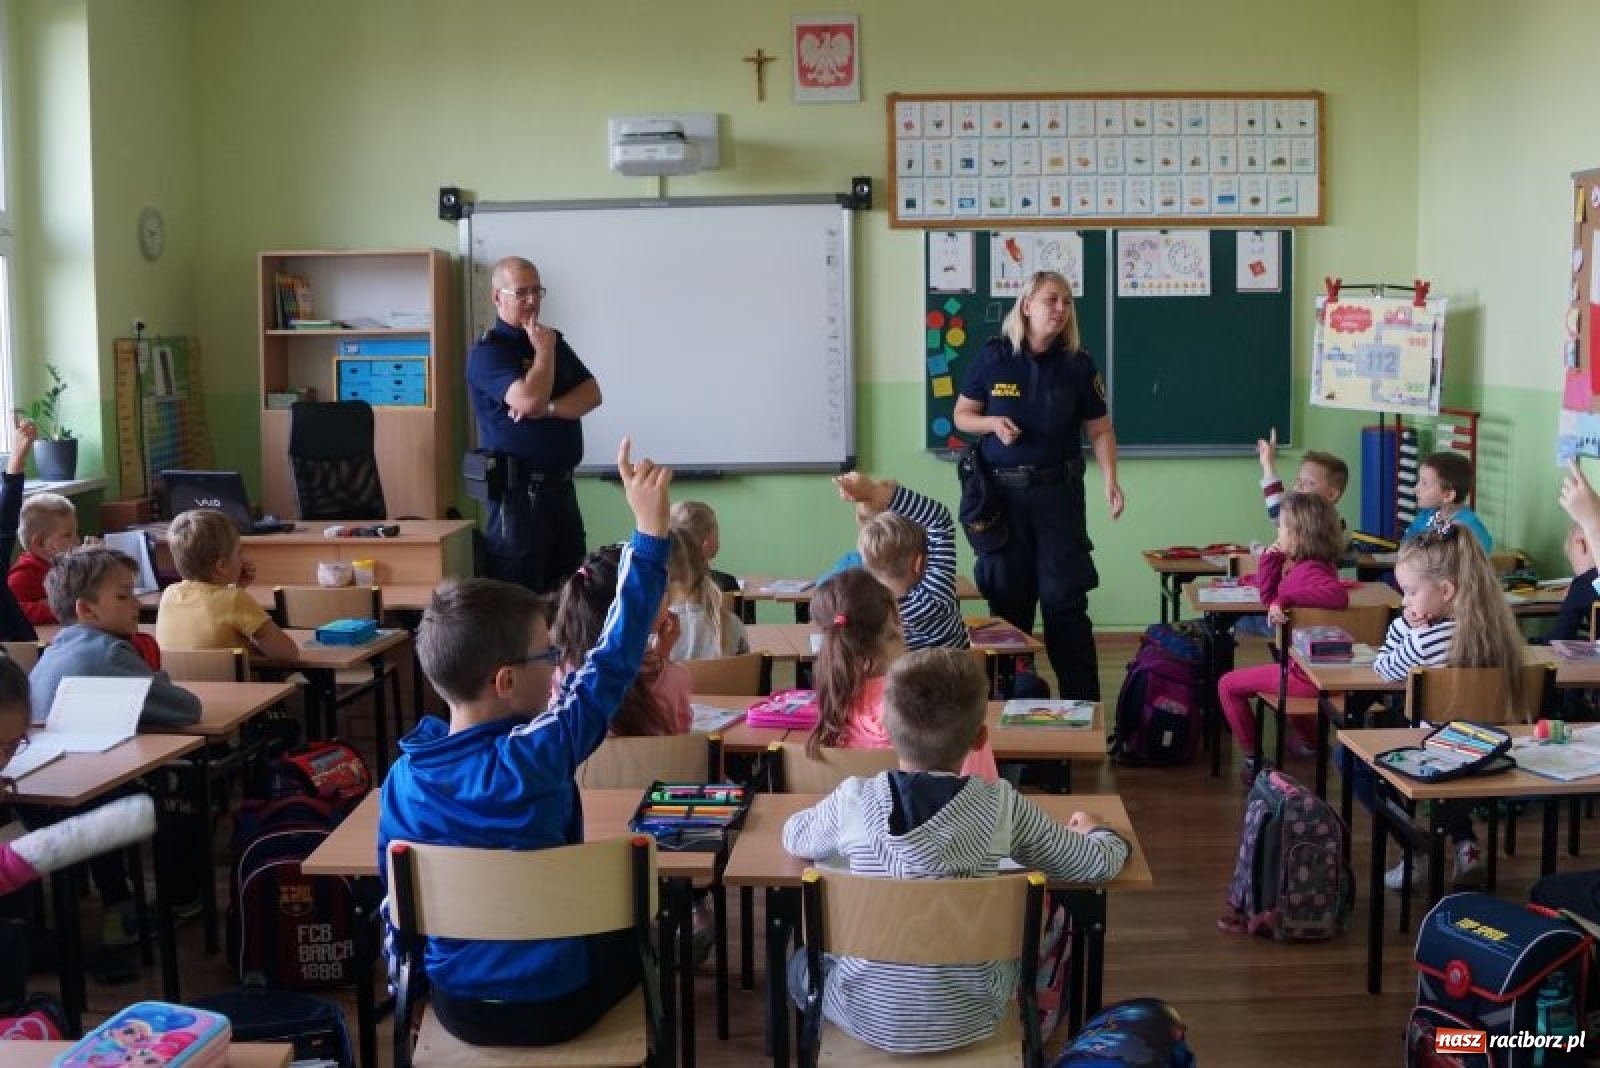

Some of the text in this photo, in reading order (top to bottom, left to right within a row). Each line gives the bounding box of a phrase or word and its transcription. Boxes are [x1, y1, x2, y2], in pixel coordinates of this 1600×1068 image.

[1366, 351, 1397, 373] 112
[297, 924, 332, 942] FCB
[298, 940, 353, 962] BARCA
